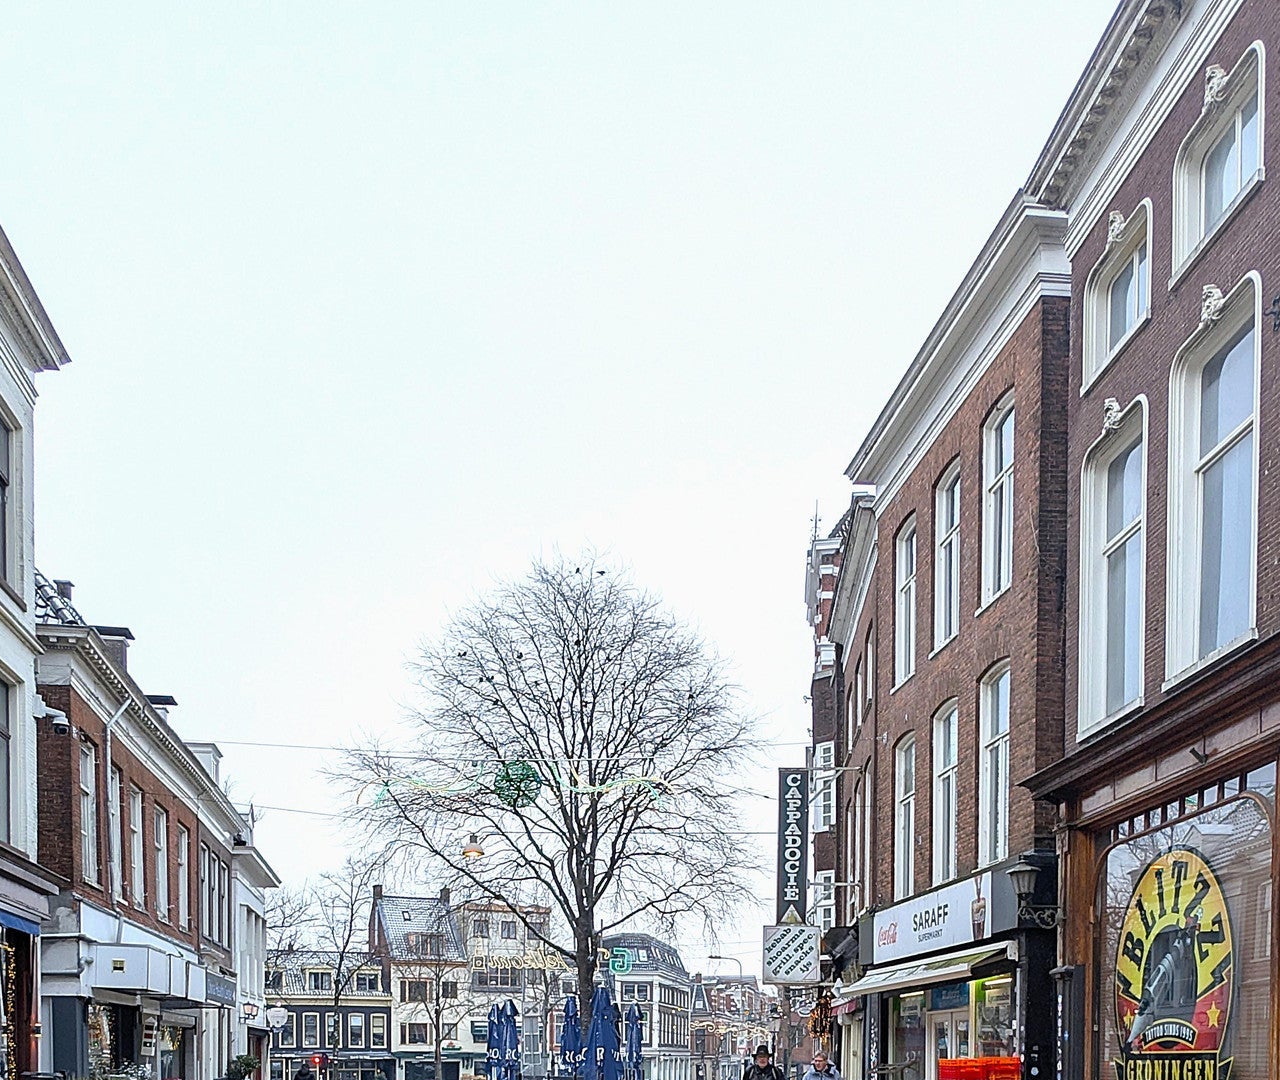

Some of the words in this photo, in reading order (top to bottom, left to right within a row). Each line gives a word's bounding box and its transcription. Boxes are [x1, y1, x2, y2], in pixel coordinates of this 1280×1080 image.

[913, 903, 949, 932] SARAFF
[765, 928, 791, 953] kebab
[766, 929, 805, 966] shoarma
[784, 945, 814, 975] snacks
